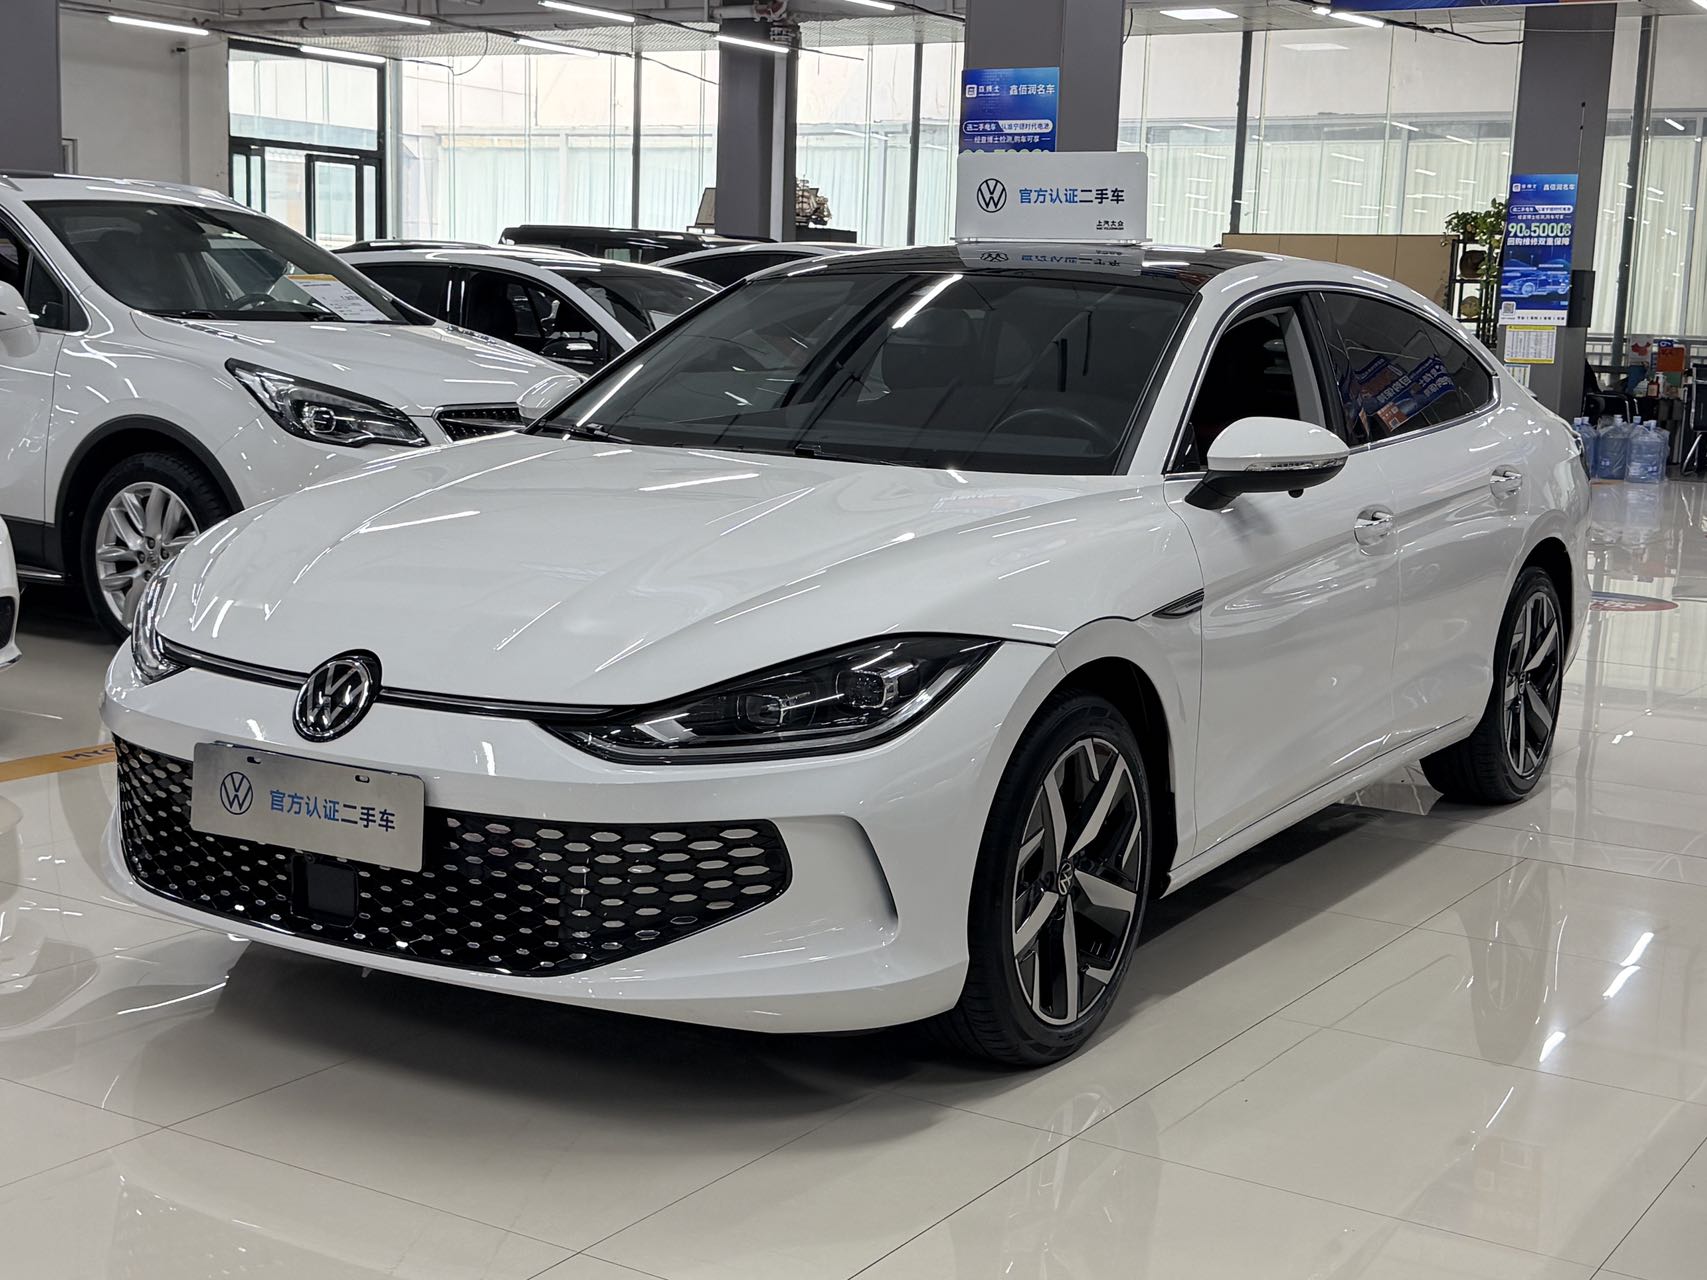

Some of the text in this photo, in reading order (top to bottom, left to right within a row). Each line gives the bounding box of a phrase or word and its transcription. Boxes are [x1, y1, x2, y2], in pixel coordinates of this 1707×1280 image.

[1009, 84, 1055, 95] 鑫佰润名车
[1019, 188, 1125, 204] 官方认证二手车
[270, 789, 396, 833] 官方认证二手车
